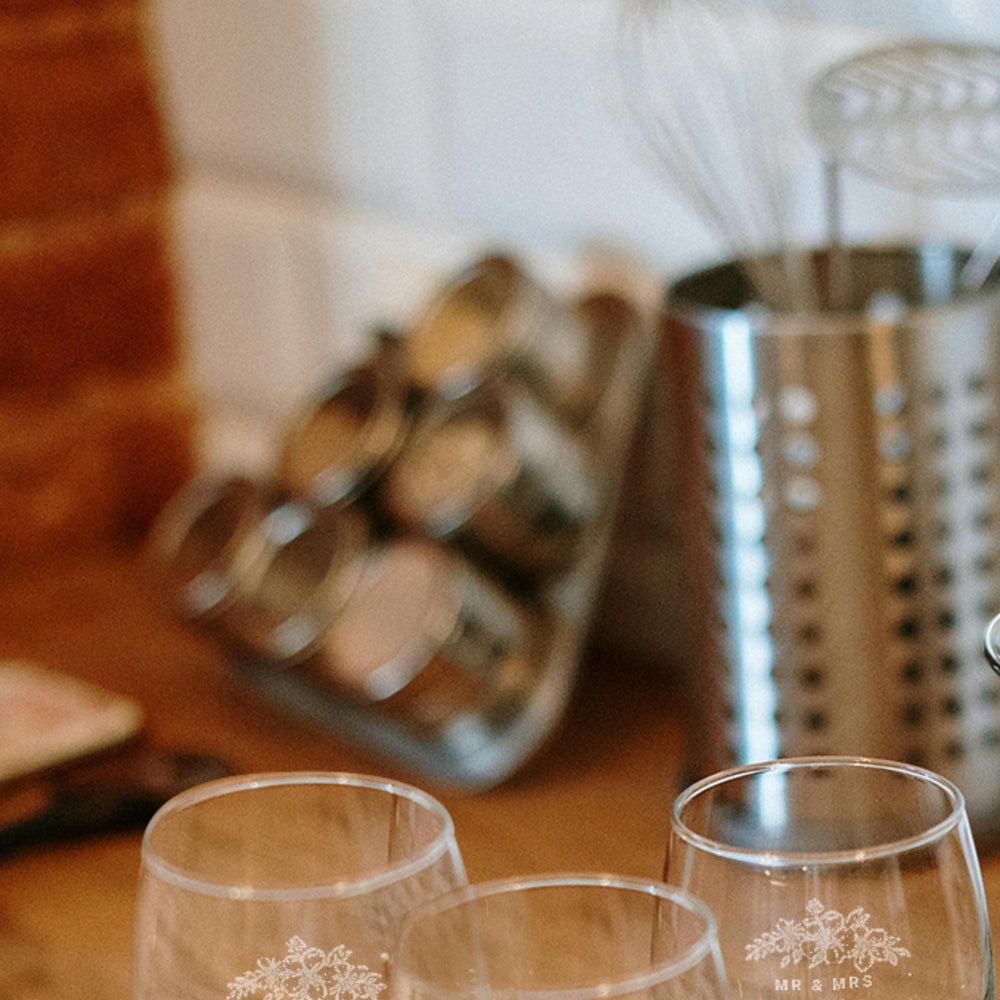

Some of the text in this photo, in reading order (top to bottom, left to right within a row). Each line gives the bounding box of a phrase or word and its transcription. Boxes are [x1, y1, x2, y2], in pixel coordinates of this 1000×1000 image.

[775, 975, 873, 992] MR & MRS
